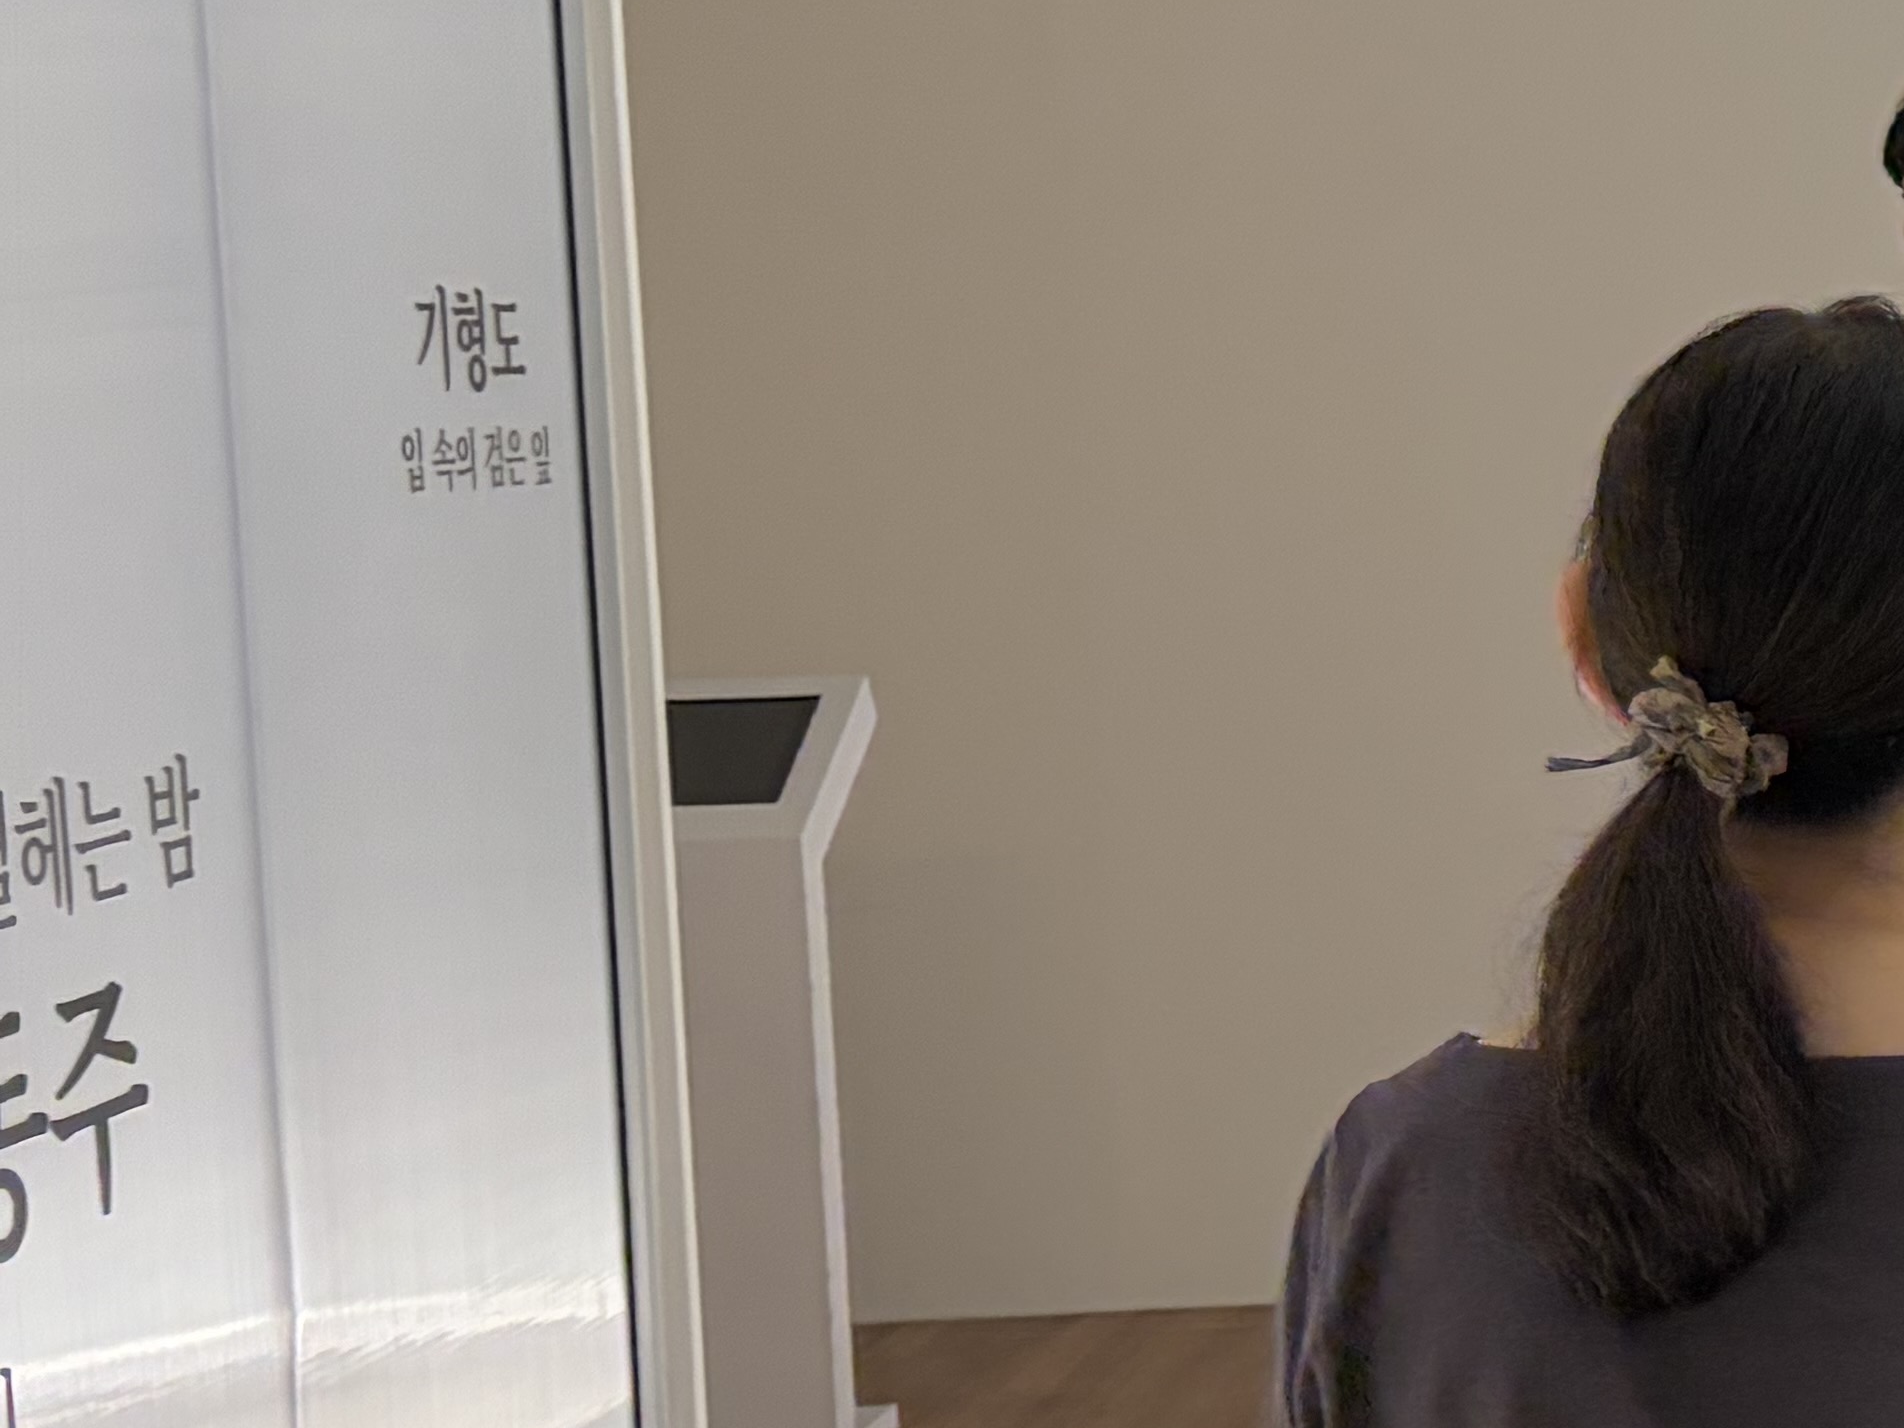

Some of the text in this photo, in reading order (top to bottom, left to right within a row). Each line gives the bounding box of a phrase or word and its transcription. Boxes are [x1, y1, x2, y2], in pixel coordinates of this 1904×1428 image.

[414, 284, 527, 393] 기형도
[400, 425, 553, 494] 입 속의 검은 잎
[0, 753, 201, 930] 헤는 밤
